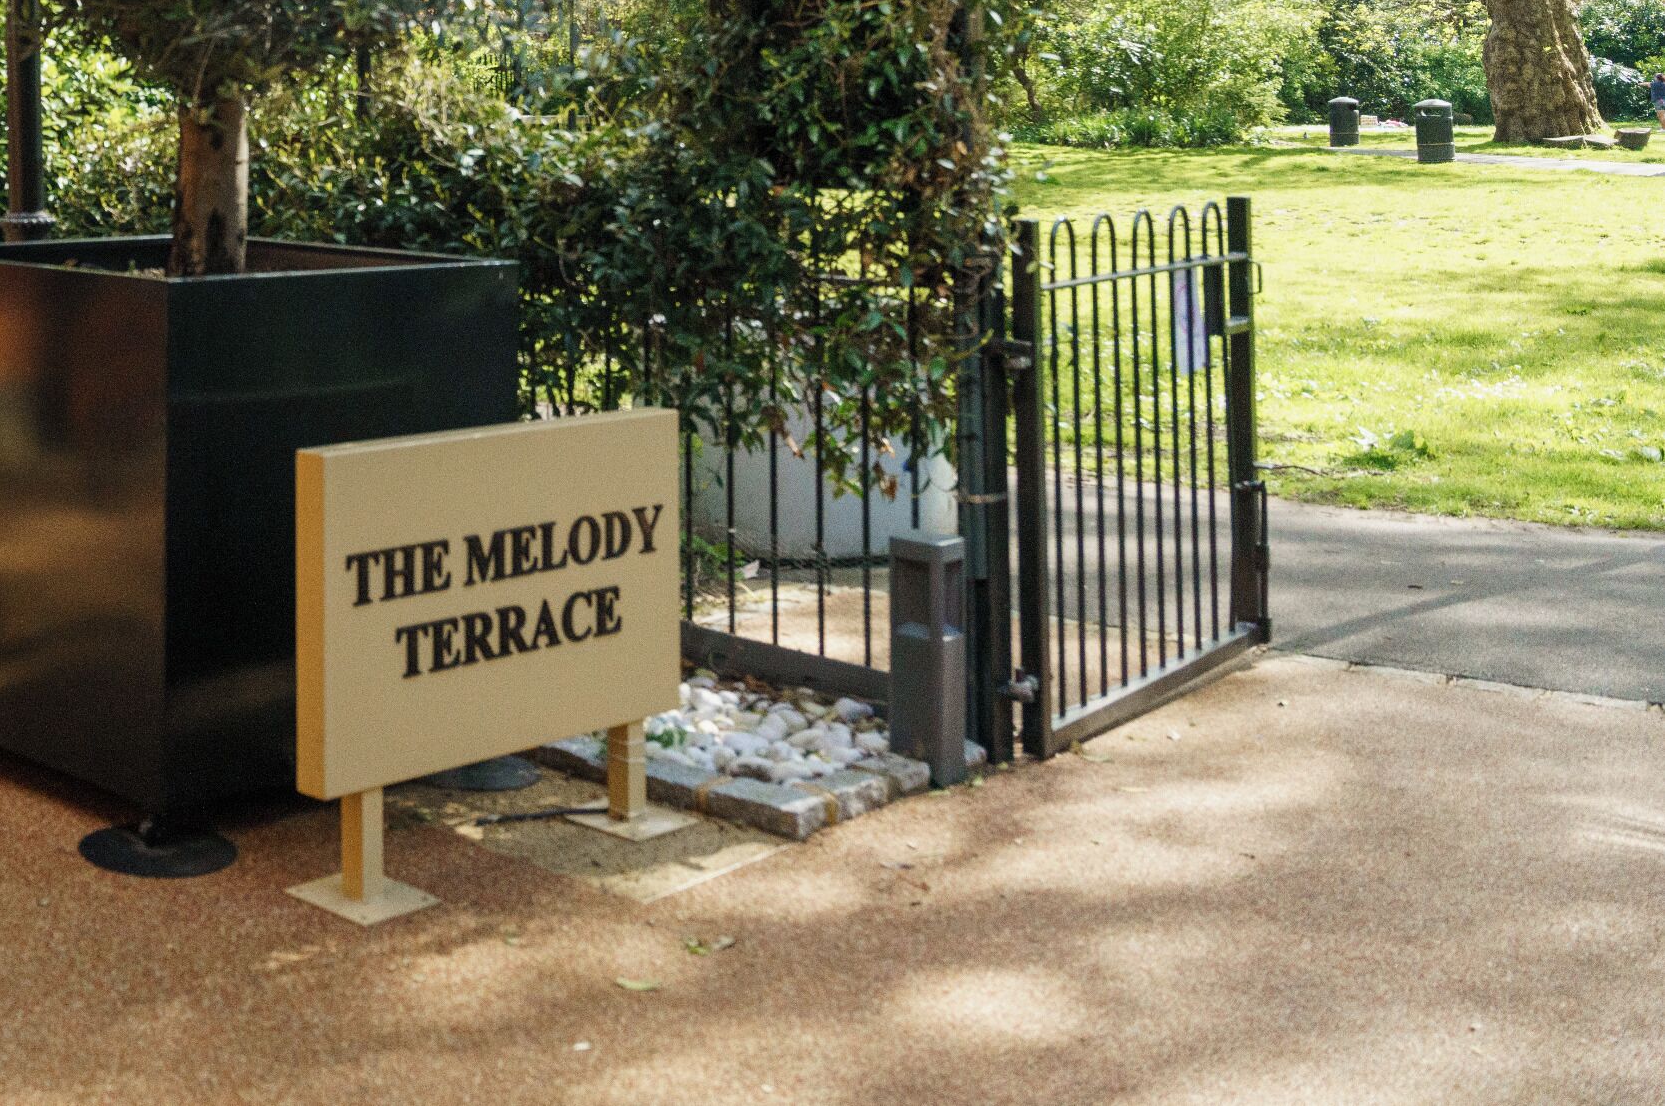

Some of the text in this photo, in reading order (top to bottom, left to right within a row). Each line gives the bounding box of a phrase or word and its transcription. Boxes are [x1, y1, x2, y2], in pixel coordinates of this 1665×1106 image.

[345, 504, 664, 607] THE MELODY
[395, 586, 623, 679] TERRACE
